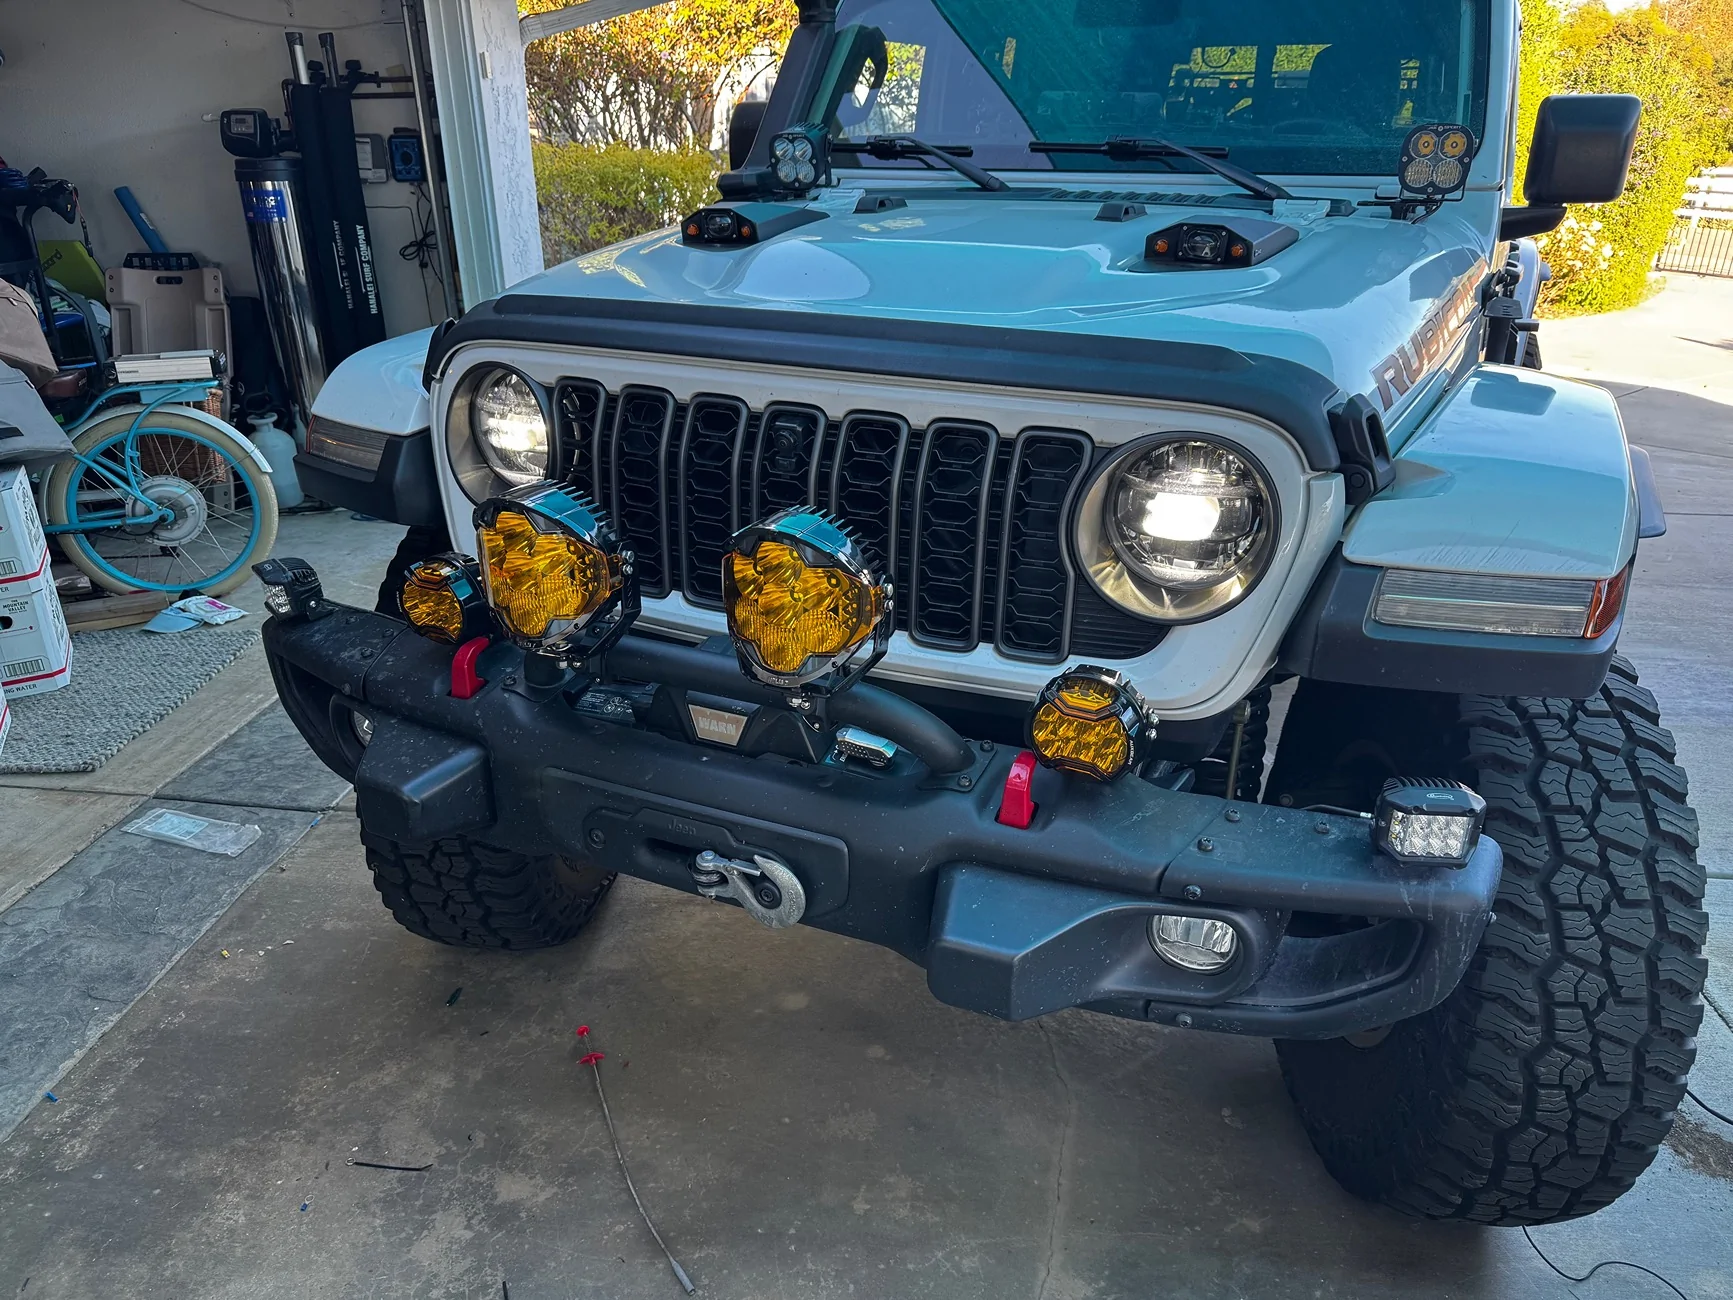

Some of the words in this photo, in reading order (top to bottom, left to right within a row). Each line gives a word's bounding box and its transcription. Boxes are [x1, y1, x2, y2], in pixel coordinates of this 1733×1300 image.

[333, 220, 345, 257] COMPANY
[355, 224, 369, 262] COMPANY
[362, 262, 373, 282] SURF
[366, 283, 379, 314] HANALEI
[2, 600, 29, 609] MOUNTAIN
[16, 683, 38, 692] WATER
[698, 716, 737, 736] WARN
[668, 818, 697, 835] Jeep
